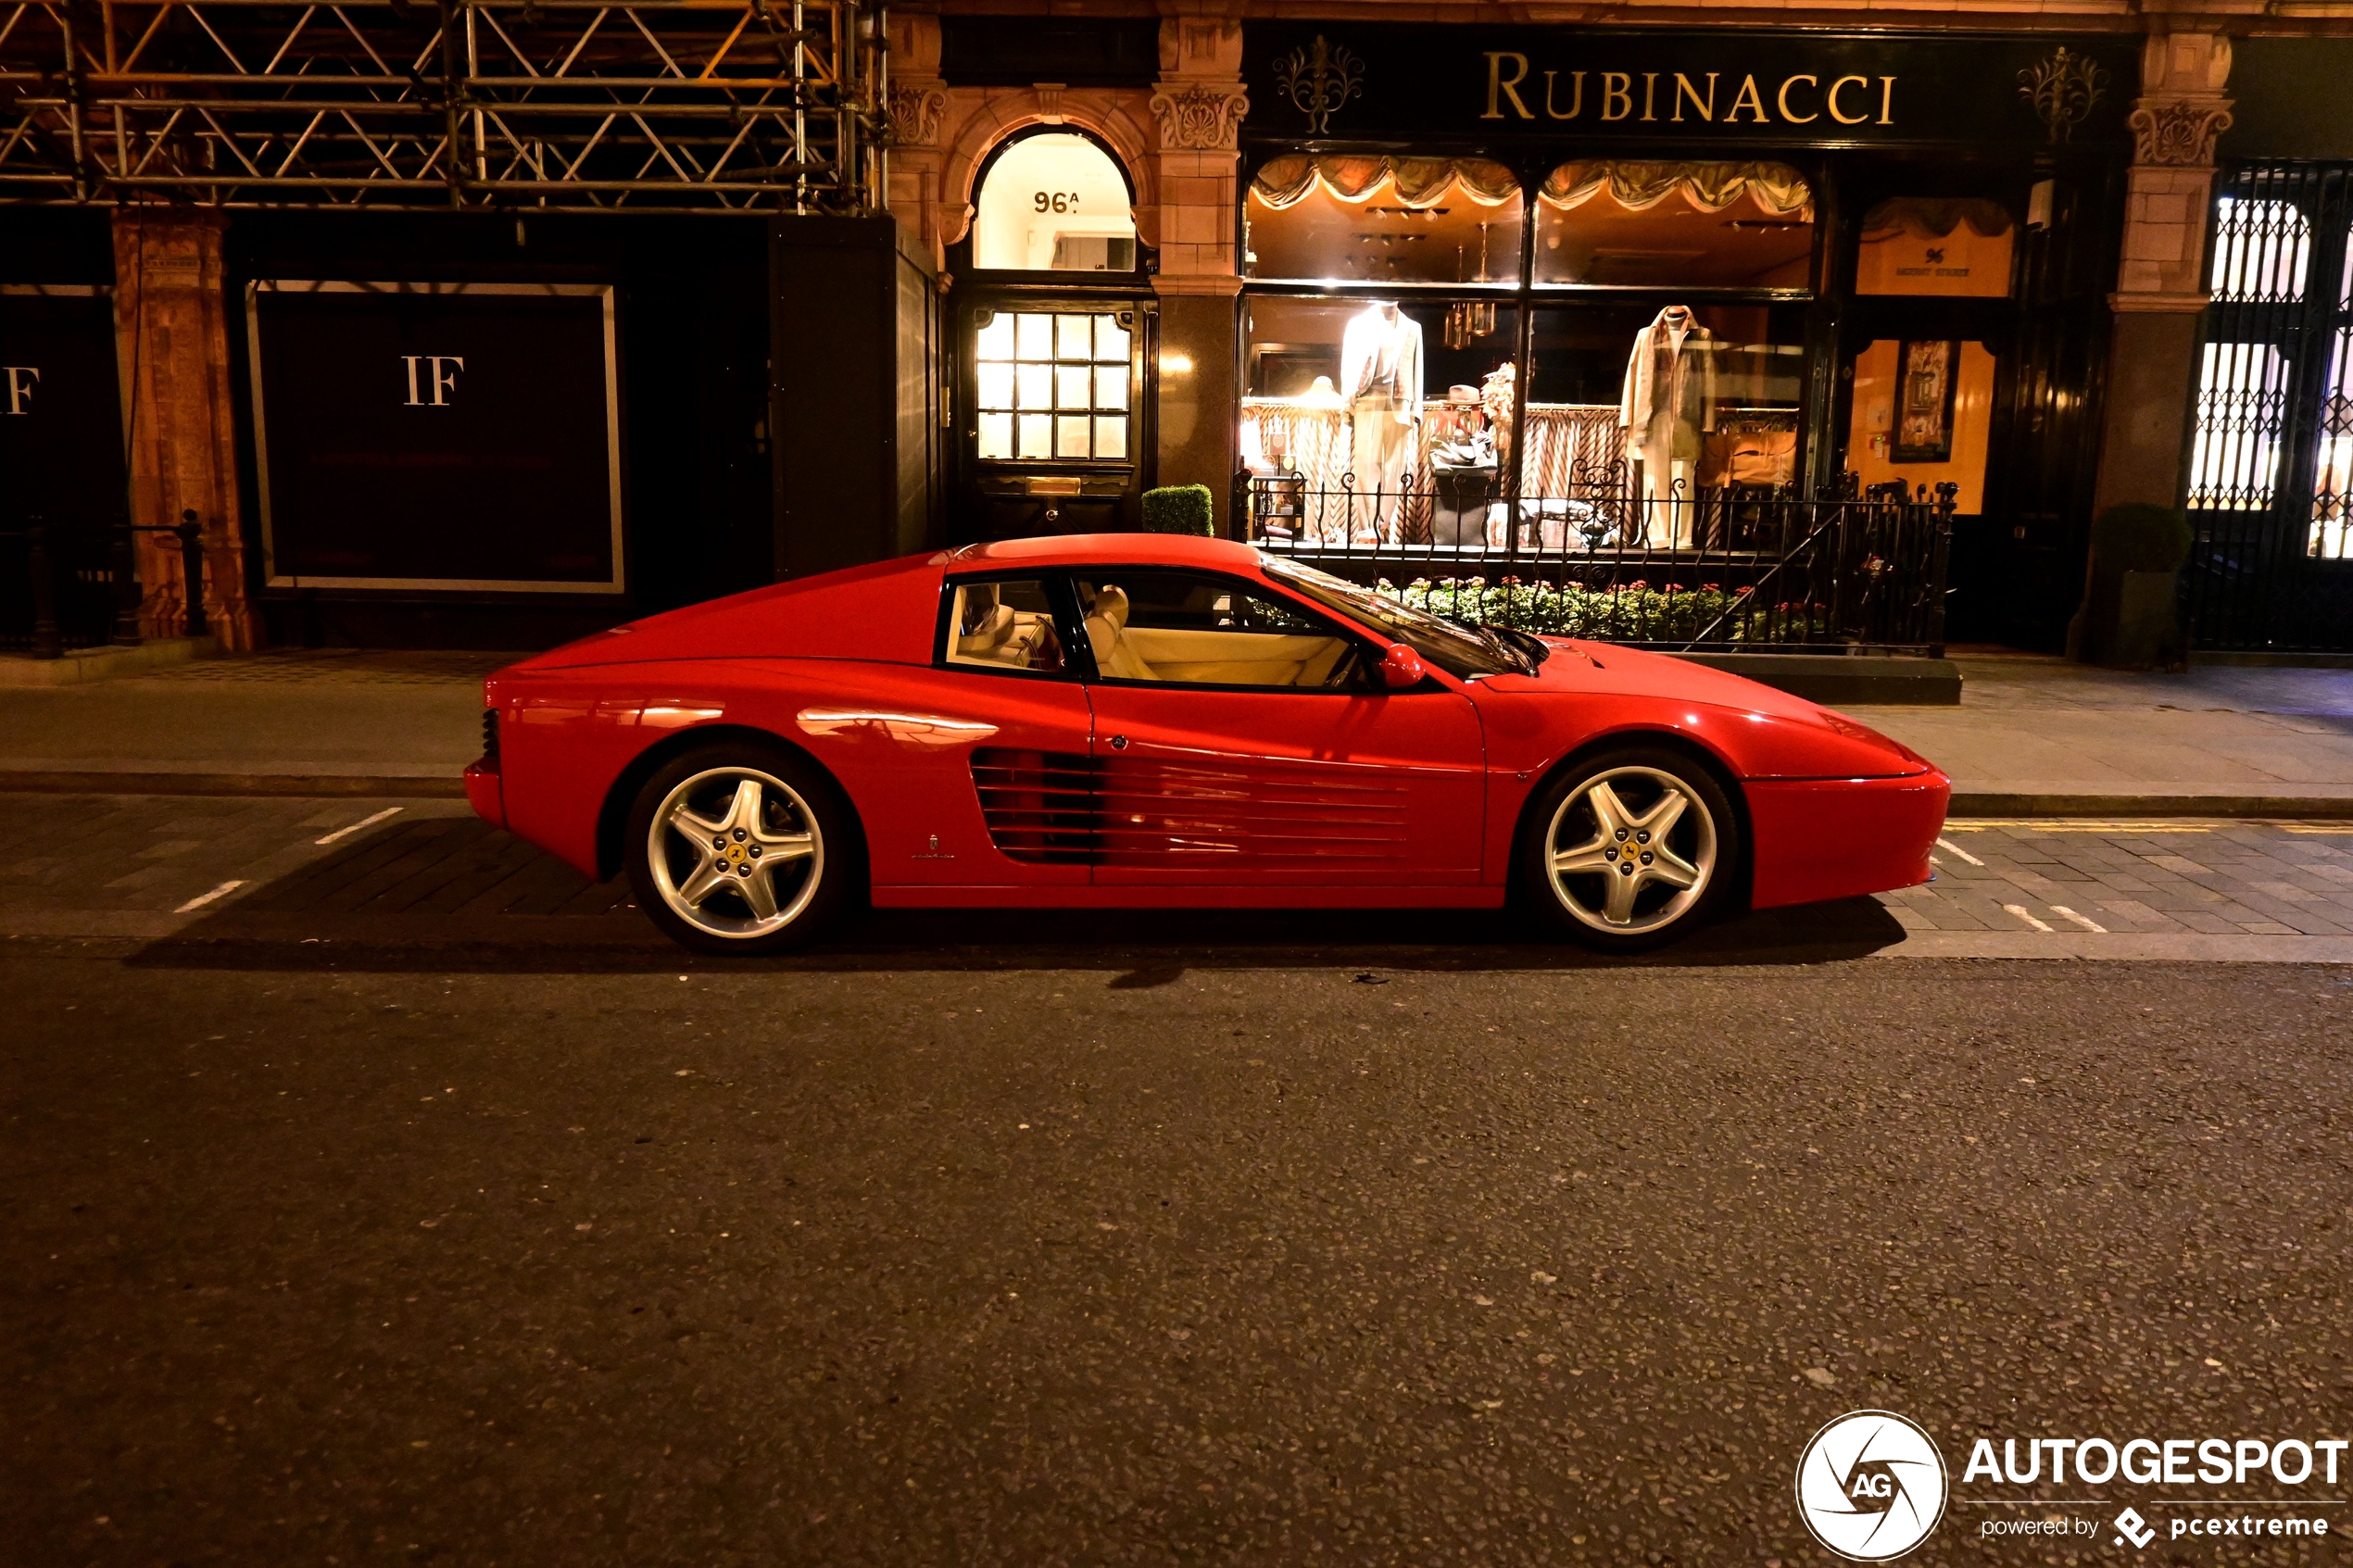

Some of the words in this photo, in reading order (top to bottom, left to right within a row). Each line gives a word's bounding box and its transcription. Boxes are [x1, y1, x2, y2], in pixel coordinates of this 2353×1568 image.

[1480, 52, 1897, 125] RUBINACCI
[1925, 248, 1945, 264] 96
[0, 367, 40, 415] F
[400, 356, 464, 406] IF
